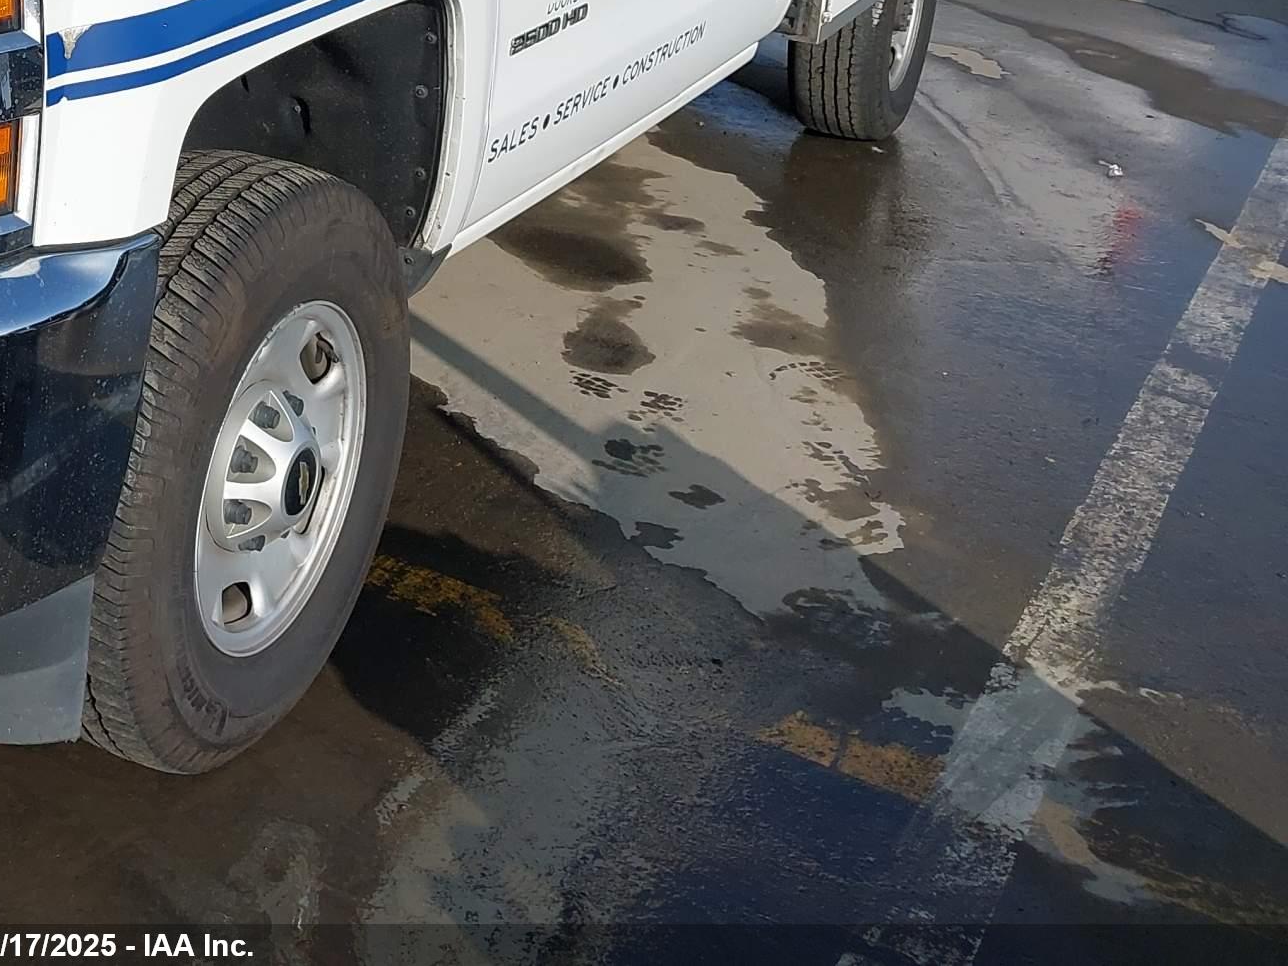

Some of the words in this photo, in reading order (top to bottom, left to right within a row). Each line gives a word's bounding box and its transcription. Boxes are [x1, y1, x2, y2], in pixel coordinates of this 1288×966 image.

[509, 16, 561, 56] 2500
[562, 3, 589, 30] HD
[487, 116, 539, 163] SALES
[553, 76, 611, 125] SERVICE
[622, 20, 707, 85] CONSTRUCTION
